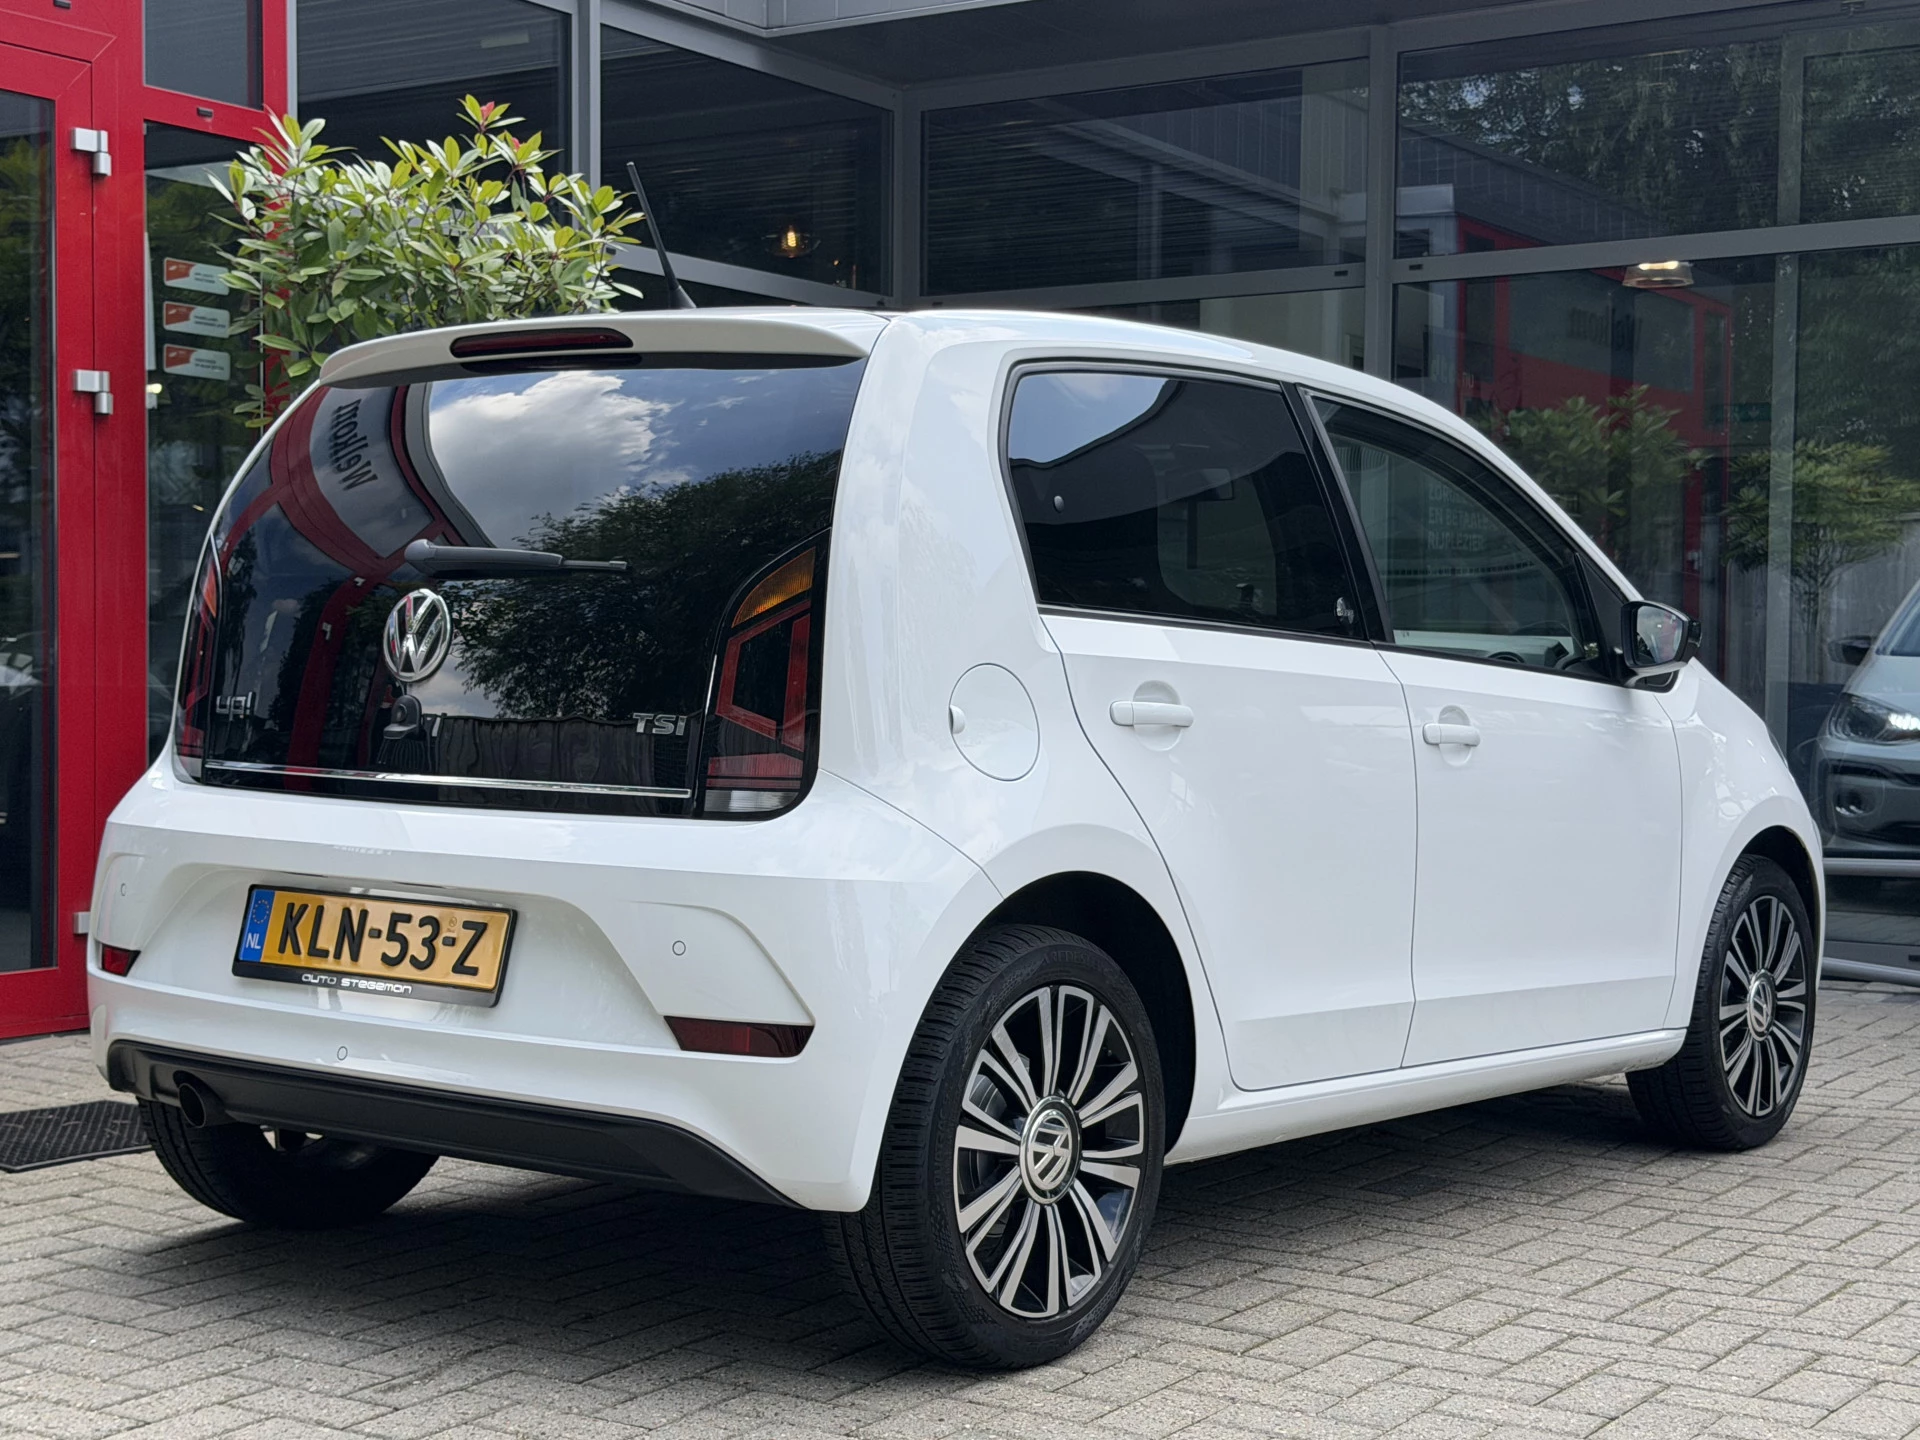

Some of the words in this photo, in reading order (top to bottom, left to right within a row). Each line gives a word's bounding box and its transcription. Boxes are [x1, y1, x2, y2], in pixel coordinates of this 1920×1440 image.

[632, 712, 688, 736] TSI
[246, 932, 262, 950] NL
[278, 902, 488, 976] KLN-53-Z
